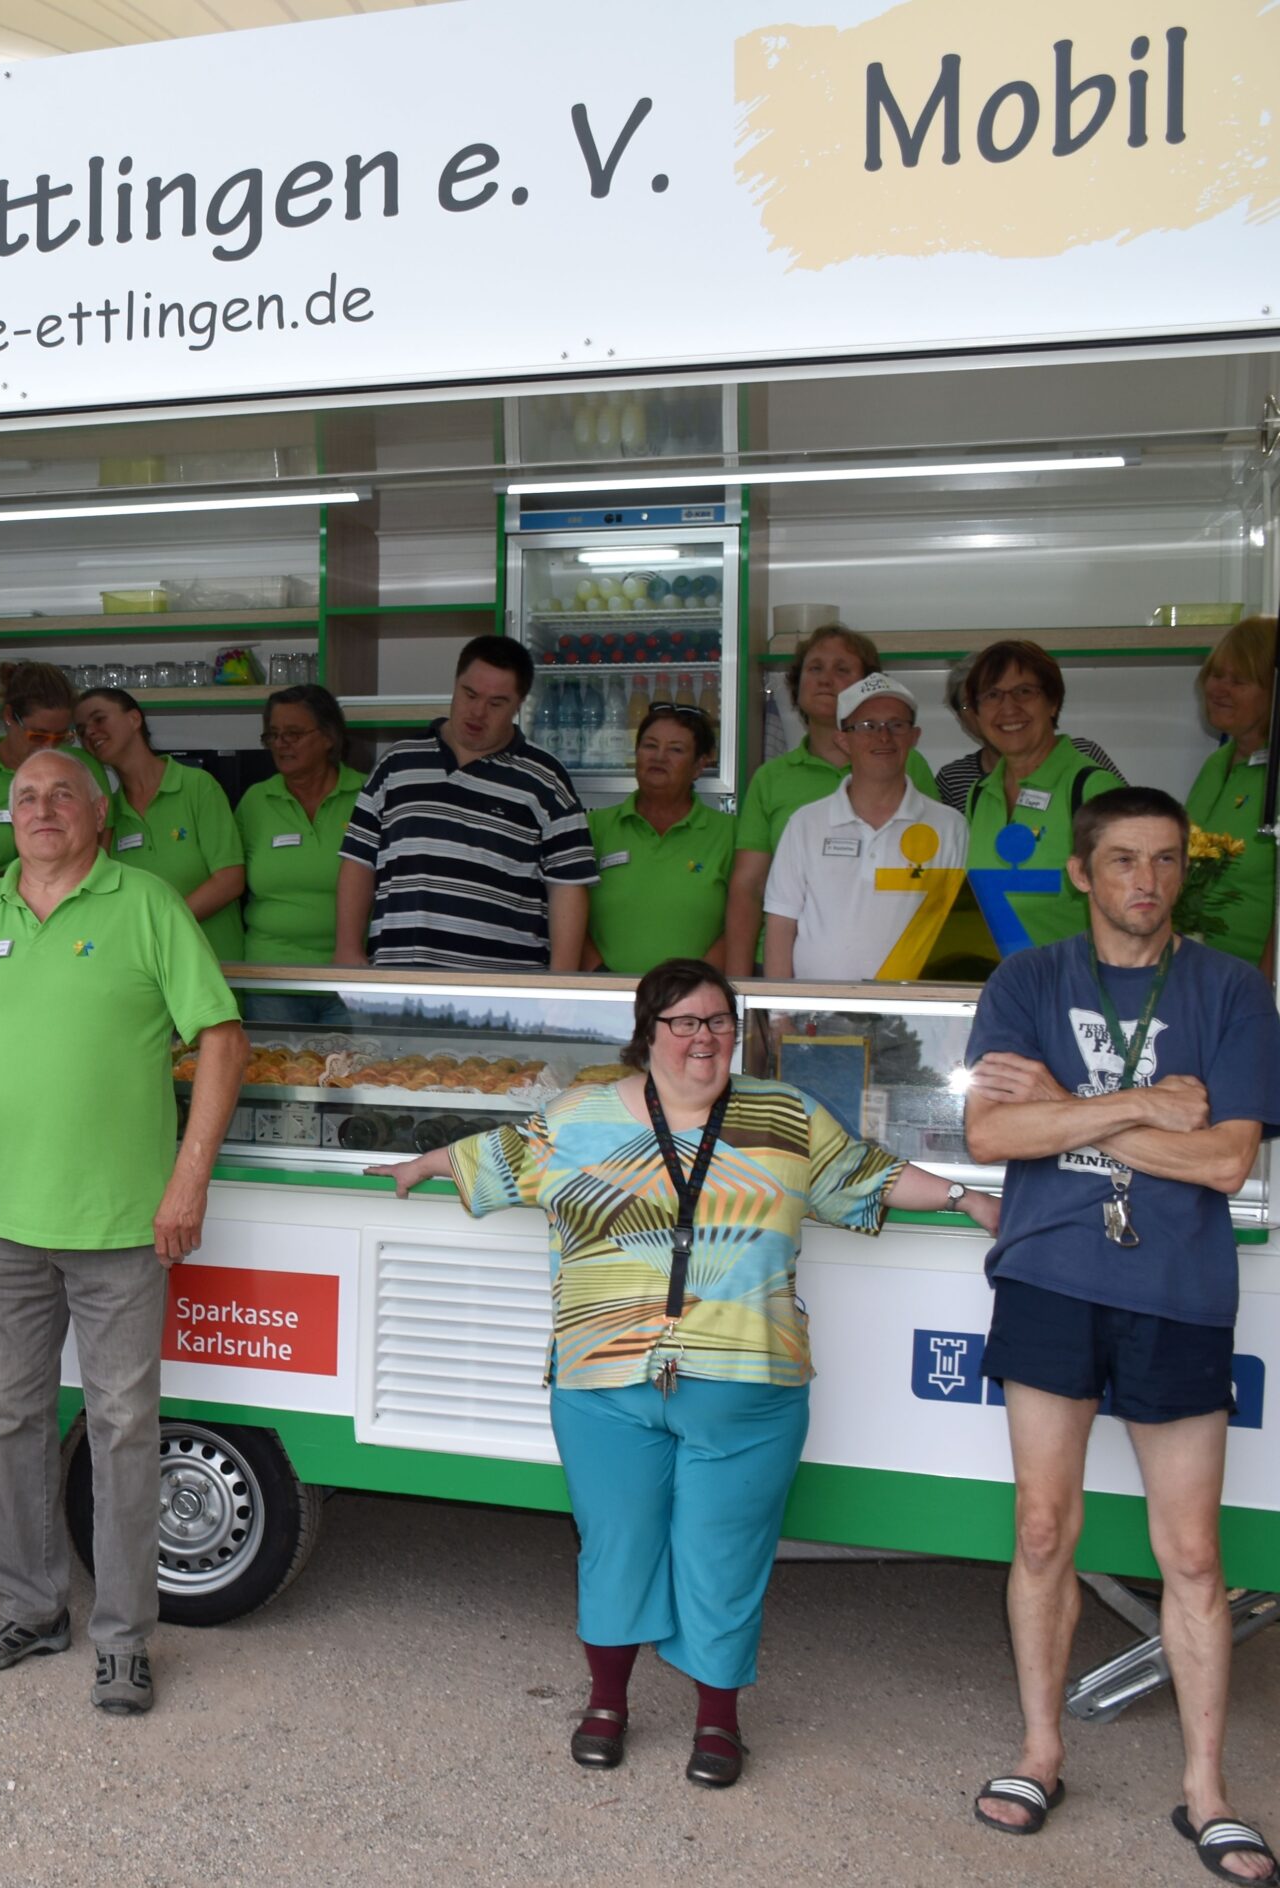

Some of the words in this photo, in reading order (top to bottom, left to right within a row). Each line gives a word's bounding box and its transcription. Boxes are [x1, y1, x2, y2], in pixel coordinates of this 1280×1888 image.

[864, 26, 1188, 172] Mobil
[438, 143, 529, 213] e.
[571, 97, 669, 199] V.
[176, 1297, 300, 1329] Sparkasse
[176, 1330, 293, 1361] Karlsruhe
